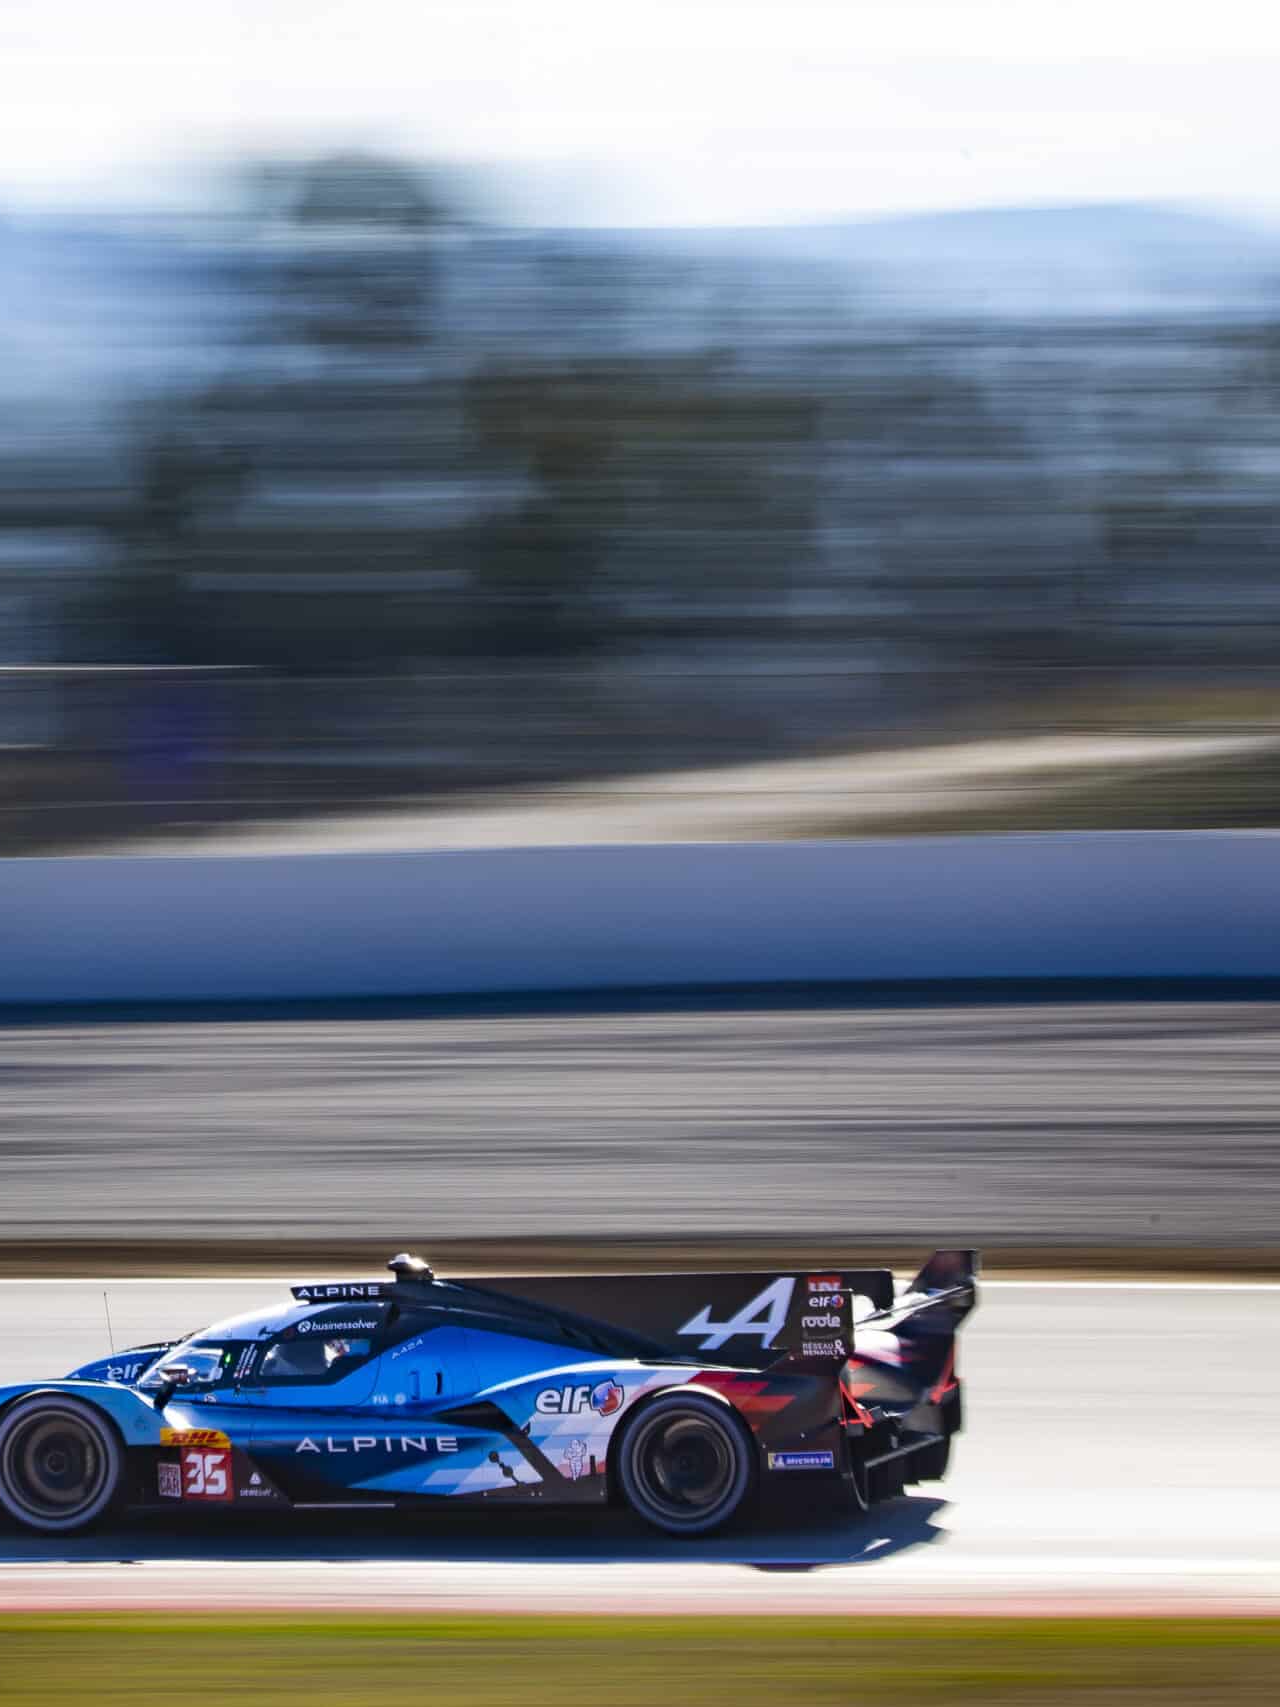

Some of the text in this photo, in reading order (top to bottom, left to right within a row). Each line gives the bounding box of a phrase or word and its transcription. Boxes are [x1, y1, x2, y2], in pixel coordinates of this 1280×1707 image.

[297, 1286, 382, 1297] ALPINE
[808, 1296, 831, 1308] elf
[311, 1319, 378, 1332] businessolver
[106, 1363, 143, 1381] elf
[535, 1385, 591, 1414] elf
[169, 1431, 220, 1444] DHL
[295, 1436, 459, 1453] ALPINE
[185, 1453, 227, 1495] 35
